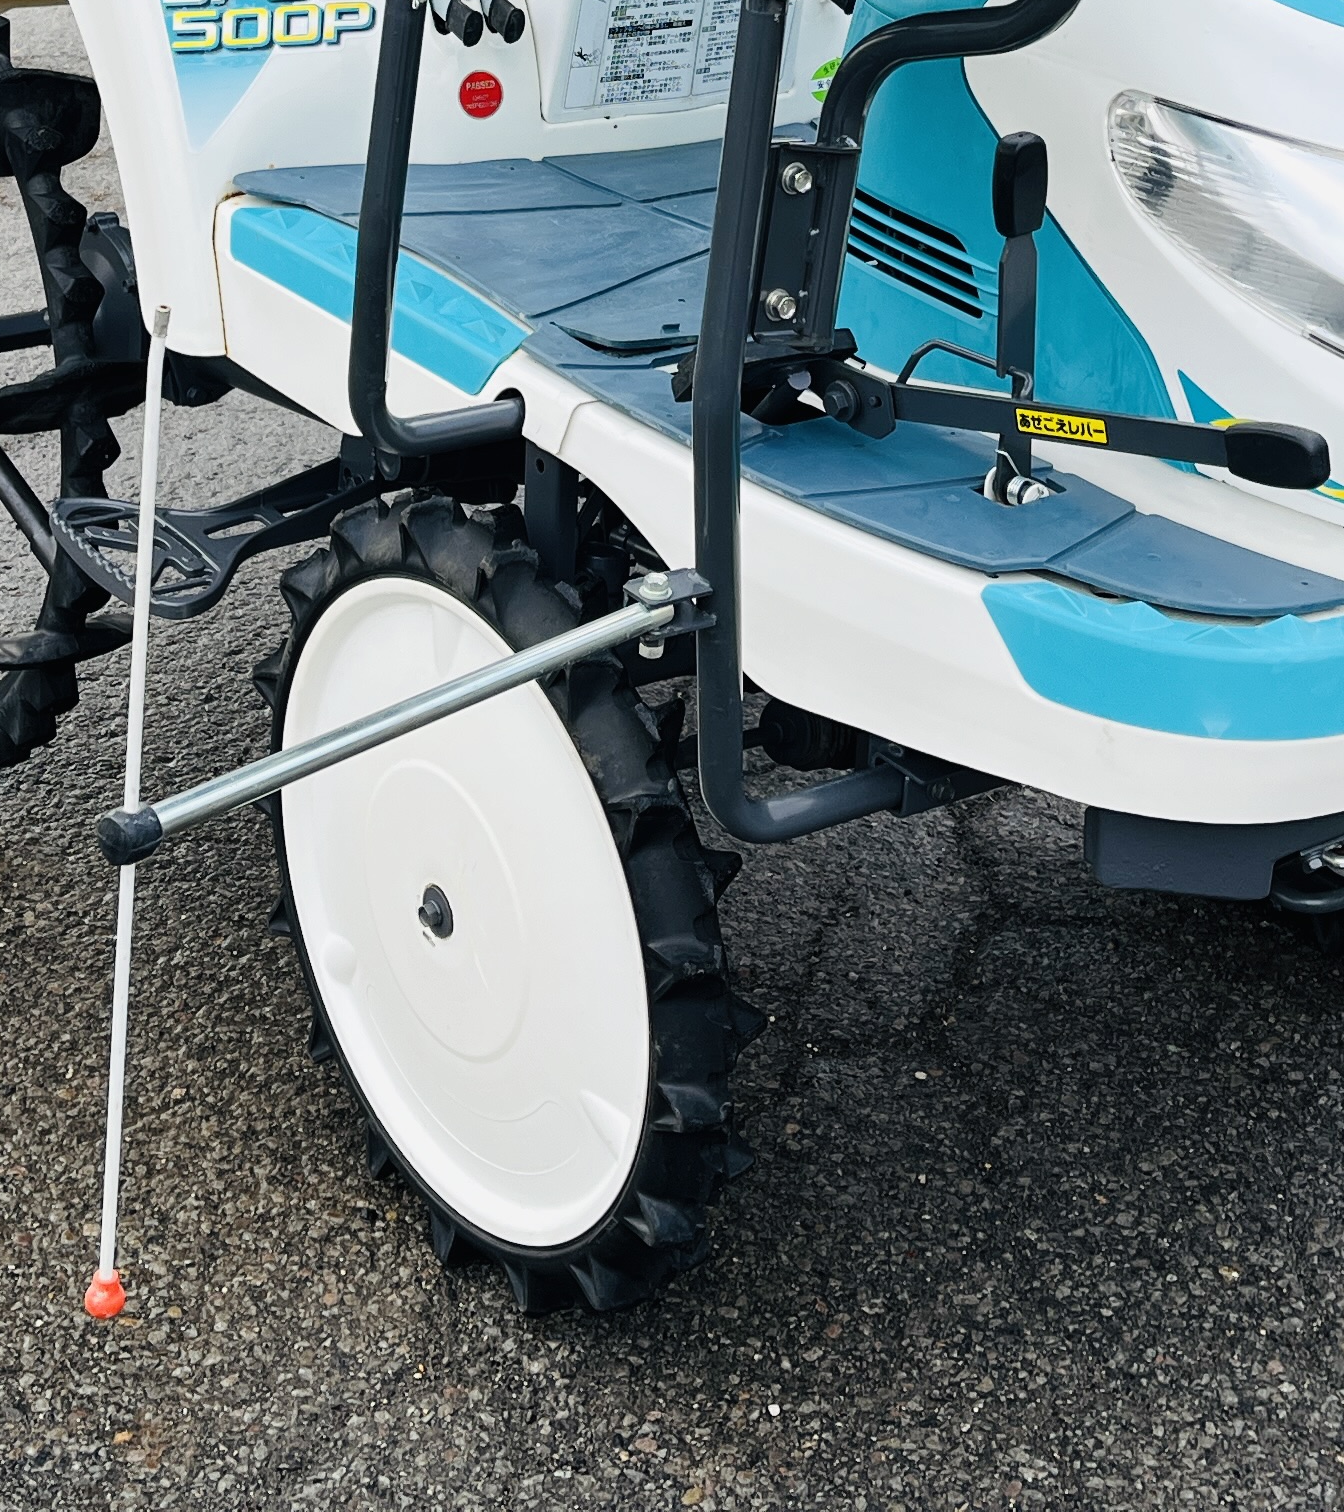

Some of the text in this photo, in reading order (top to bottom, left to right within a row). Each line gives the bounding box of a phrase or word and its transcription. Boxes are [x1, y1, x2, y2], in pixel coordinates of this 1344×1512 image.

[171, 1, 376, 53] 500P
[1018, 413, 1105, 438] あぜごえレバー
